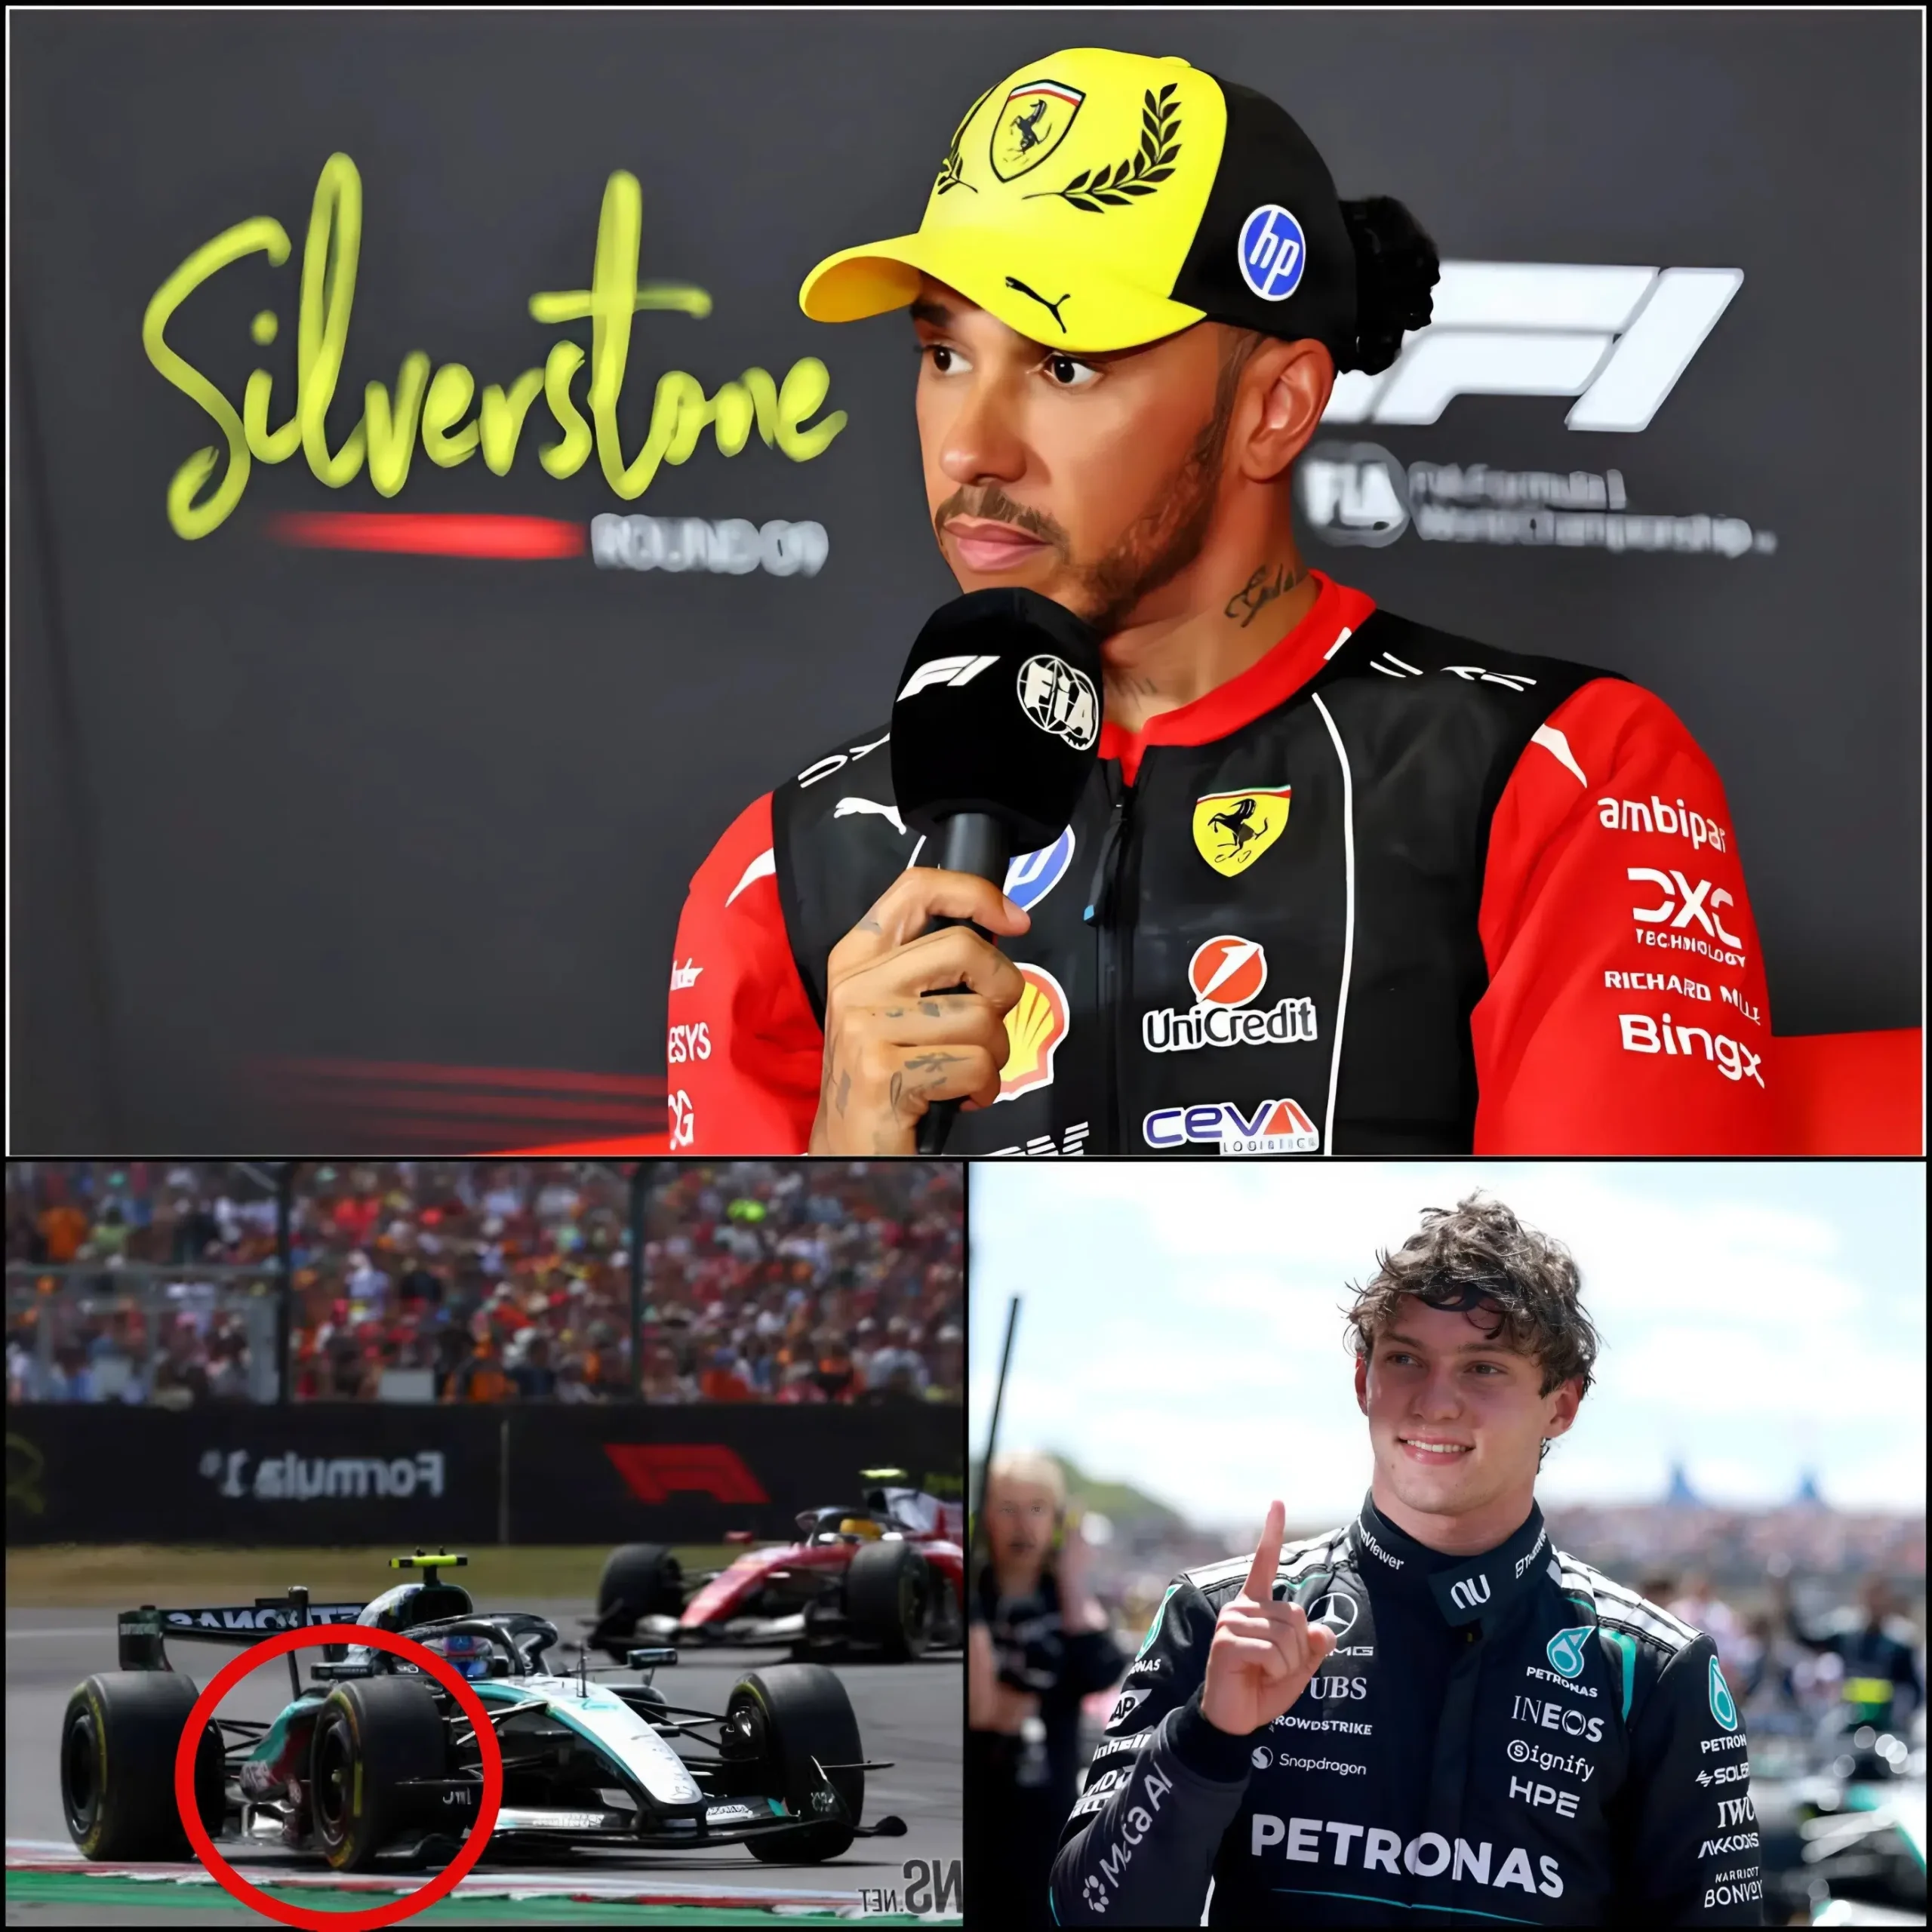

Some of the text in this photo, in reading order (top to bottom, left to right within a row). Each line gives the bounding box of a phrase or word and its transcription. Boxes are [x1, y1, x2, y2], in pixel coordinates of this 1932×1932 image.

[1245, 208, 1302, 297] hp
[143, 152, 848, 540] Silverstone
[896, 654, 1001, 703] F1
[1019, 657, 1097, 744] FIA
[1626, 867, 1743, 949] DXC
[1604, 971, 1712, 1001] RICHARD
[1146, 1004, 1314, 1049] UniCredit
[1326, 1646, 1374, 1657] MG
[1310, 1675, 1367, 1700] UBS
[1526, 1666, 1598, 1698] PETRONAS
[1272, 1715, 1373, 1736] ROWDSTRIKE
[1511, 1695, 1605, 1743] INEOS
[1278, 1752, 1367, 1776] Snapdragon
[1509, 1775, 1581, 1819] HPE
[1251, 1813, 1564, 1899] PETRONAS
